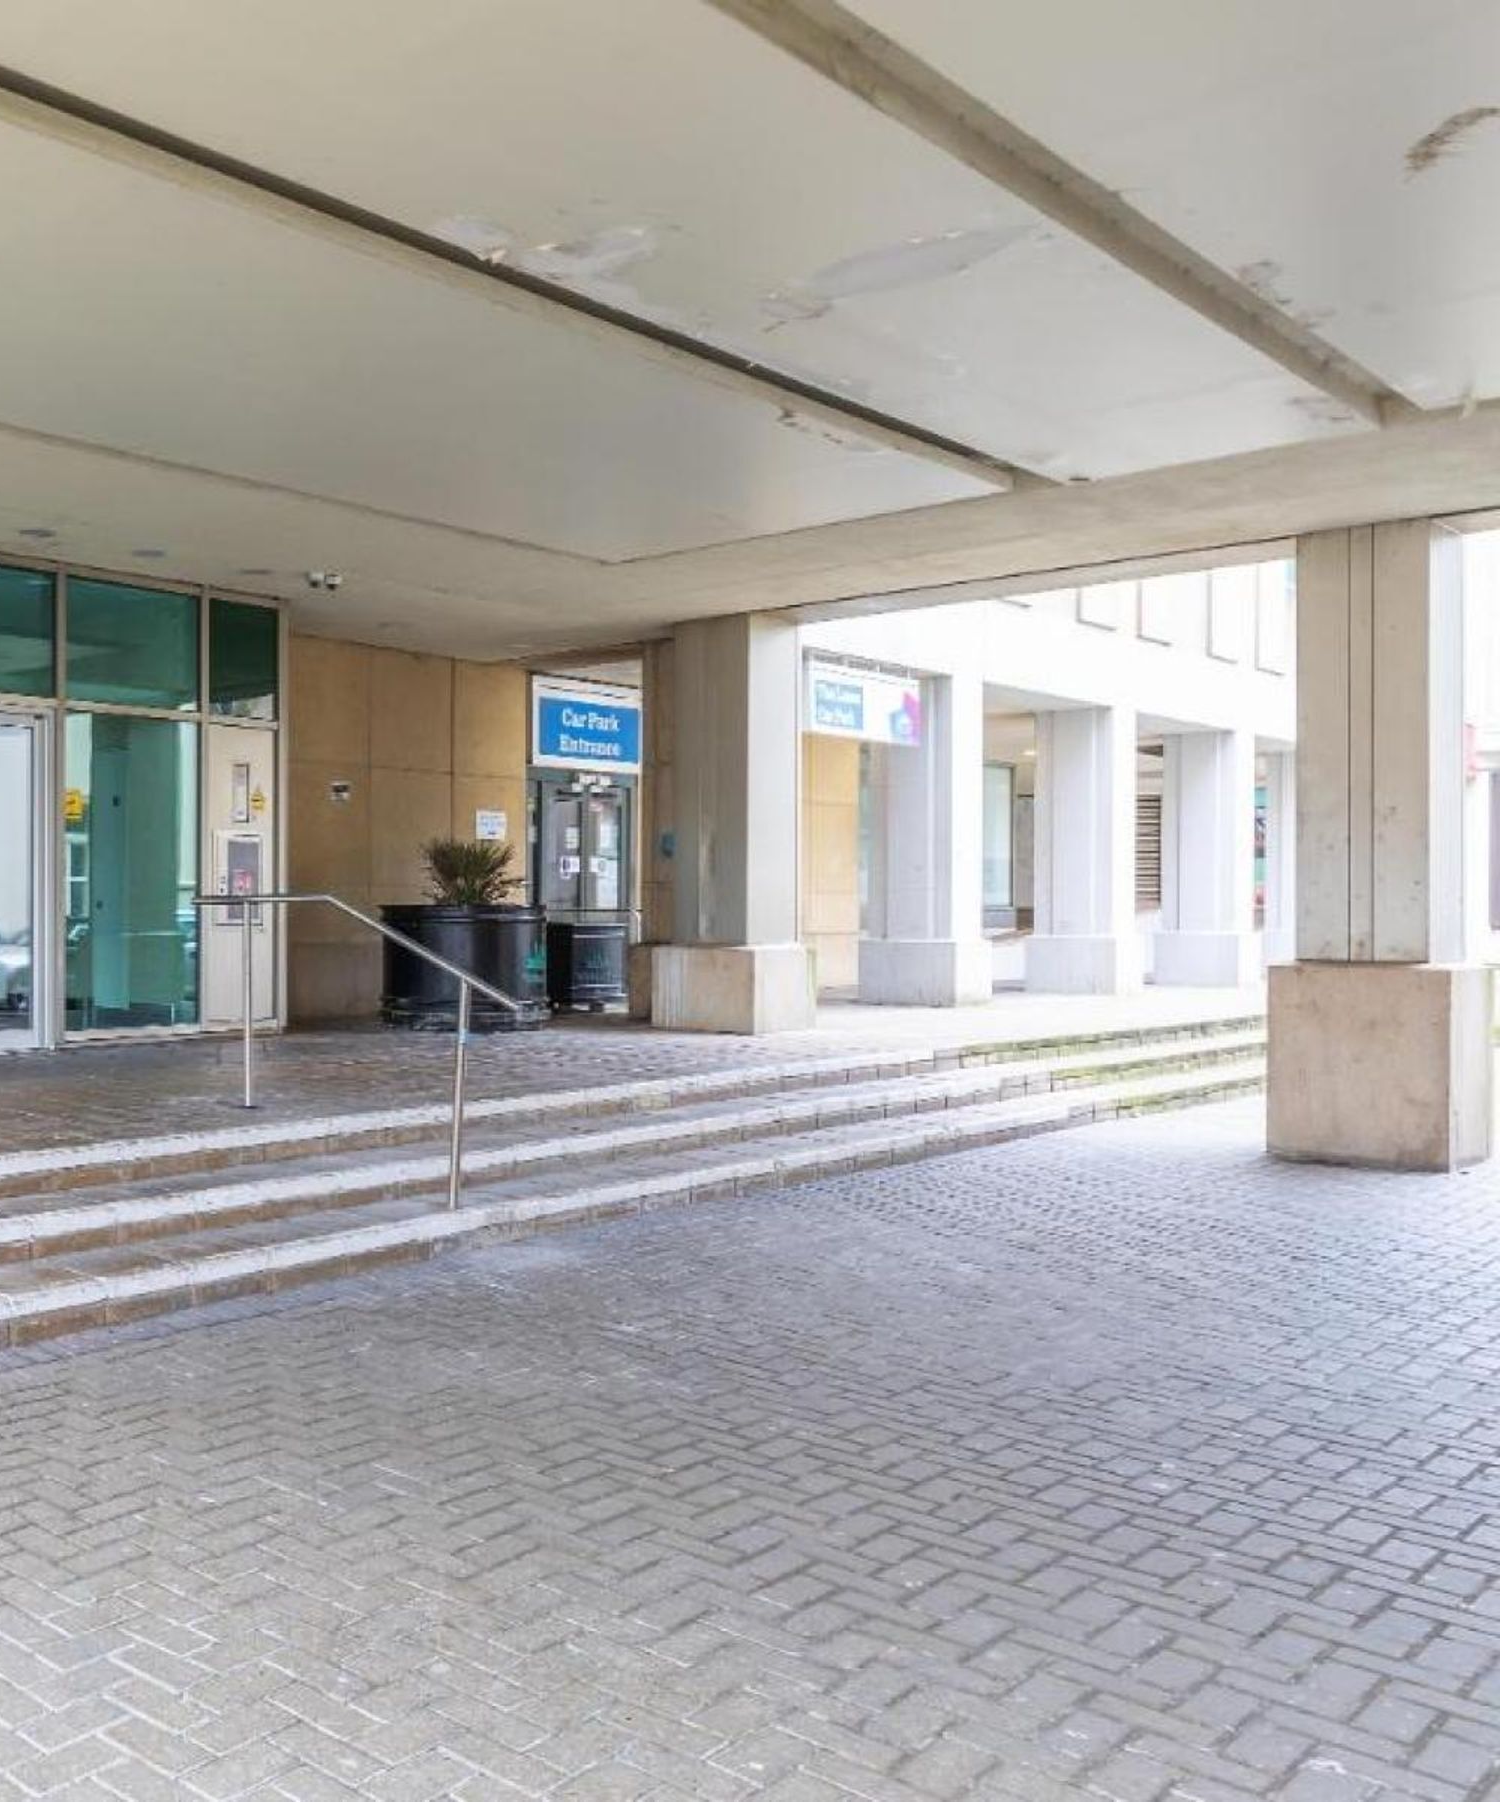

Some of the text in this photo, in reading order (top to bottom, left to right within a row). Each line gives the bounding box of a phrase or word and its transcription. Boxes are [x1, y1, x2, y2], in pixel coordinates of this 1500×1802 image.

[562, 708, 620, 732] Car Park
[559, 733, 620, 756] Entrance
